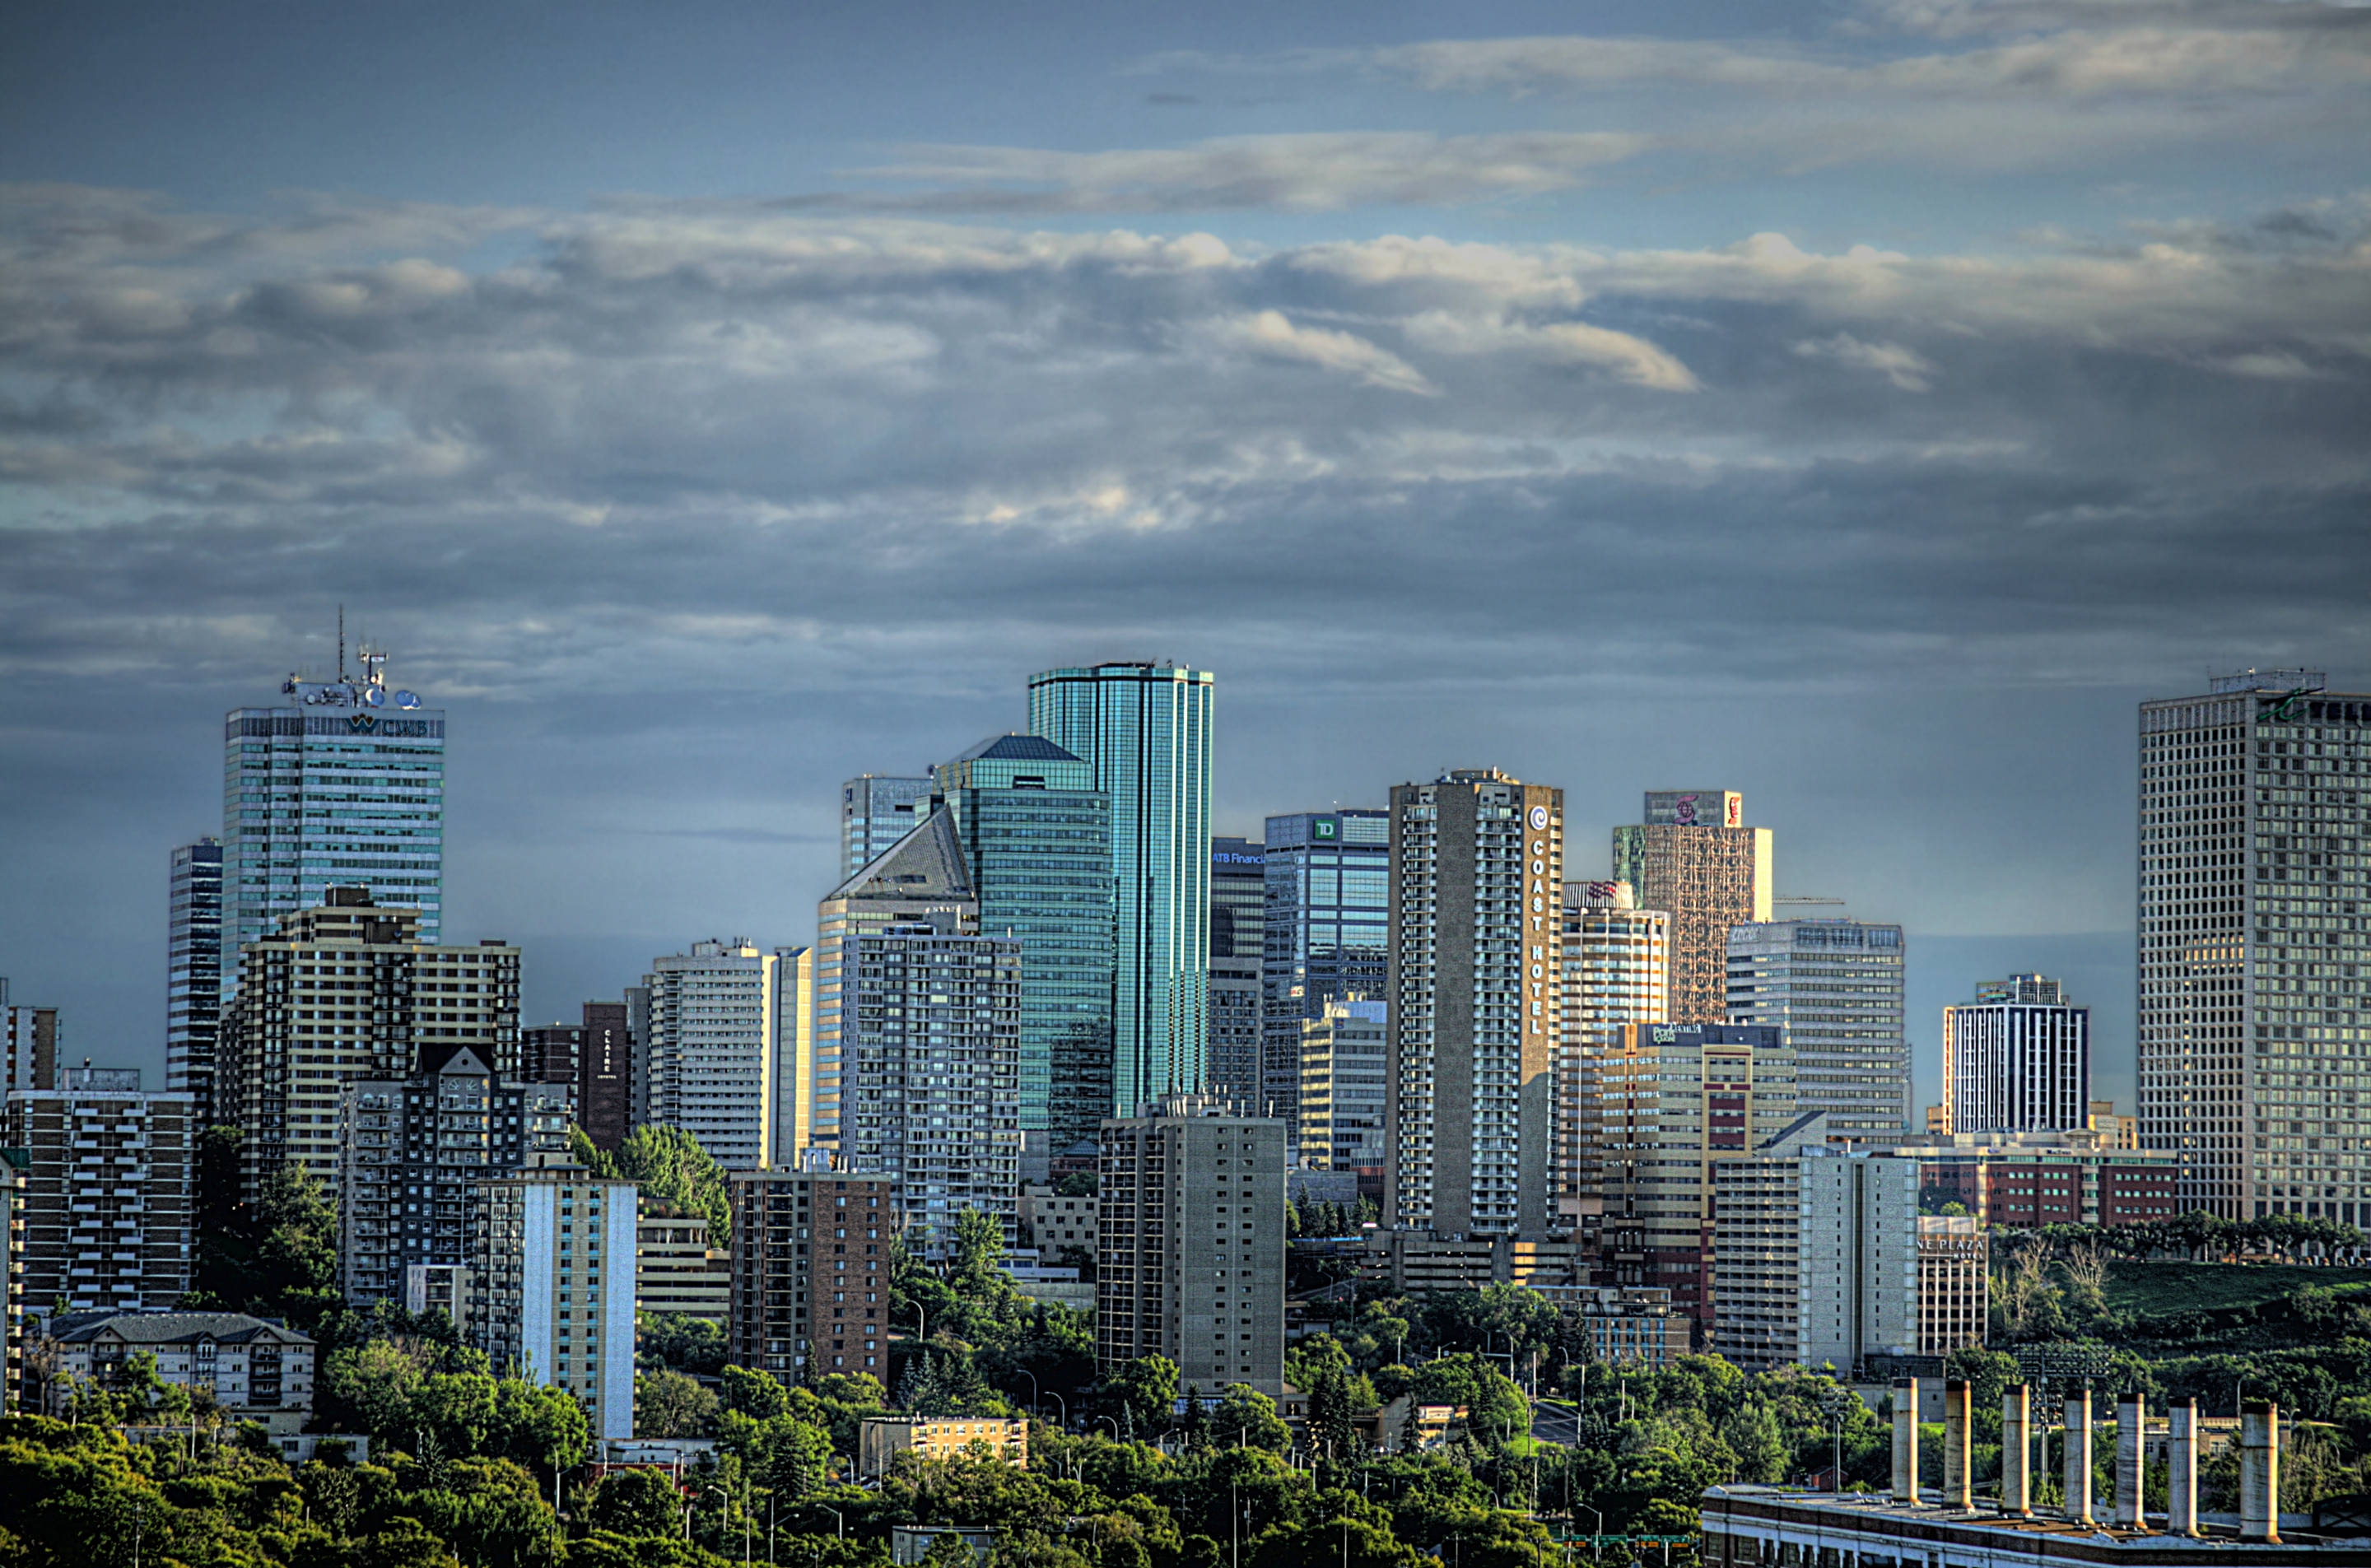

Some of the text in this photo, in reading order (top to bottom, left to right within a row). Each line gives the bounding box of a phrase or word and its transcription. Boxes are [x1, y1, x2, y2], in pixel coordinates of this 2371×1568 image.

[383, 719, 428, 735] CWB
[1317, 823, 1334, 835] TD
[1212, 853, 1230, 863] ATB
[1532, 840, 1544, 1034] COAST HOTEL
[1653, 1022, 1675, 1038] Park
[1940, 1240, 1983, 1249] PLAZA
